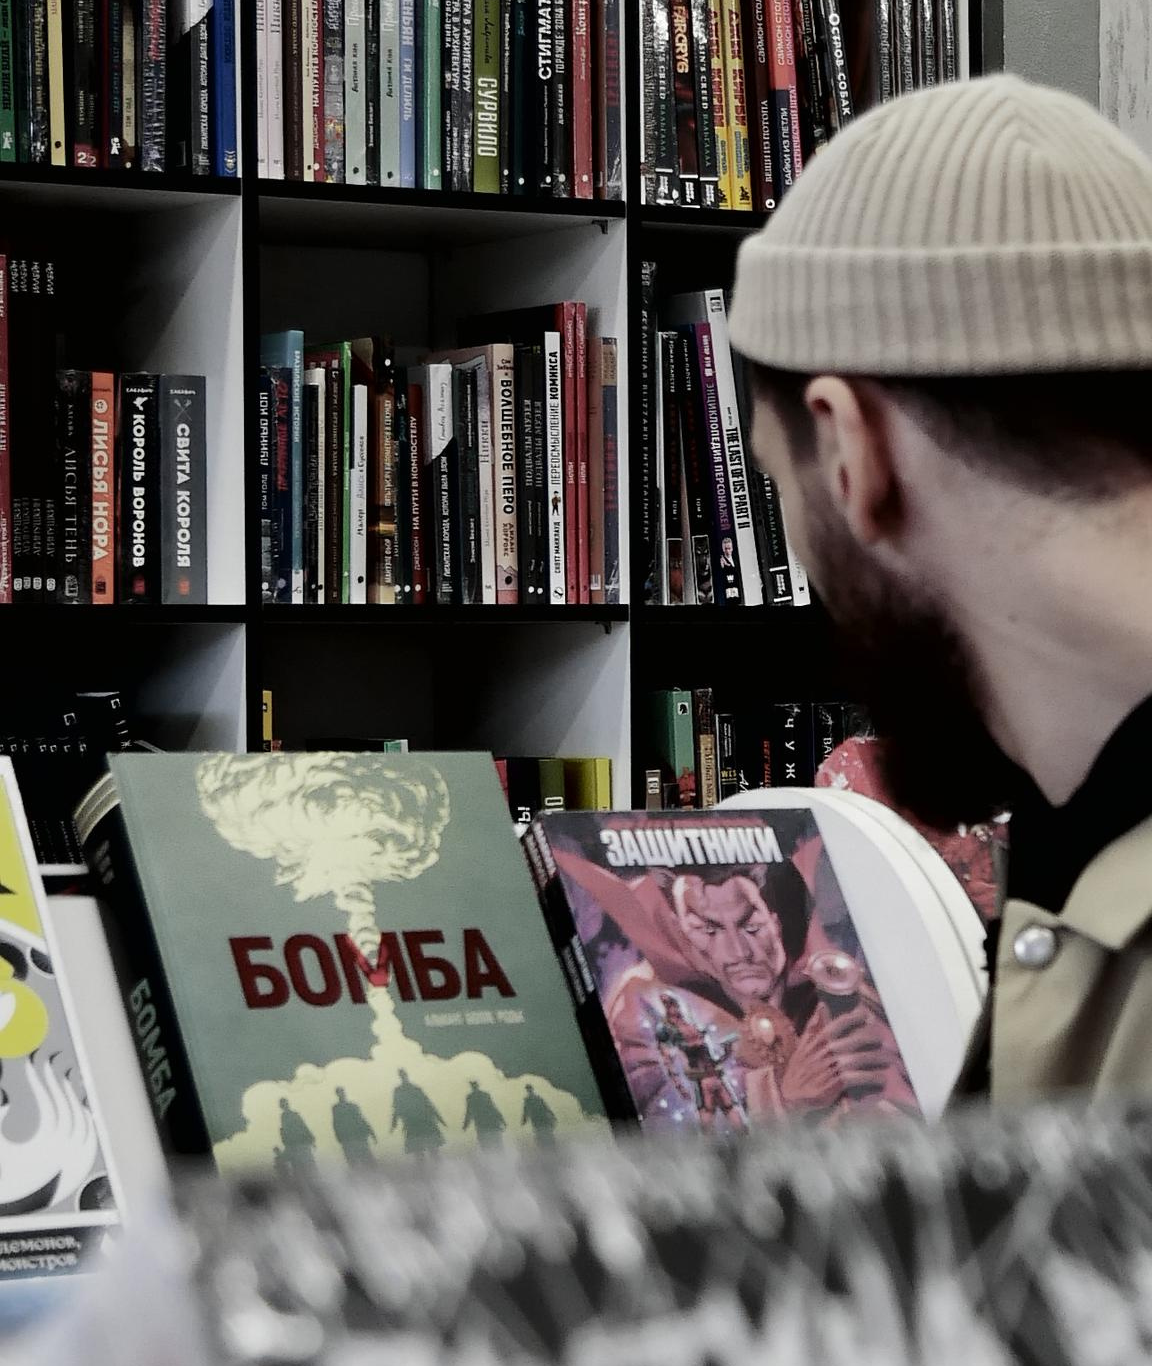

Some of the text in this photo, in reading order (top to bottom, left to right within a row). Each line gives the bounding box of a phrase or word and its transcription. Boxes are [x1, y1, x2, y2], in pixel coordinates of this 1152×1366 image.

[402, 68, 412, 121] ДЕЛИЛЬ
[828, 12, 851, 116] ОСТРОВ СОБАК
[477, 76, 498, 157] СУРВИЛО
[780, 107, 793, 186] БАЙКИ ИЗ ПЕТЛИ
[260, 418, 268, 466] ЛУННЫЙ
[409, 416, 419, 480] КОМПОСТЕЛУ
[501, 379, 514, 515] ВОЛШЕБНОЕ ПЕРО
[548, 351, 561, 485] ПЕРЕОСМЫСЛЕНИЕ КОМИКСА
[706, 382, 732, 532] ЭНЦИКЛОПЕДИЯ ПЕРСОНАЖЕЙ
[725, 427, 739, 444] THE
[727, 444, 742, 468] LAST
[65, 446, 77, 563] ЛИСЬЯ ТЕНЬ
[92, 418, 111, 561] ЛИСЬЯ НОРА
[132, 413, 146, 568] КОРОЛЬ ВОРОНОВ
[176, 422, 191, 568] СВИТА КОРОЛЯ
[411, 490, 420, 515] ПУТИ
[411, 516, 420, 530] НА
[733, 494, 748, 516] PART
[600, 825, 784, 868] ЗАЩИТНИКИ
[227, 928, 517, 1010] БОМБА
[129, 976, 176, 1119] БОМБА
